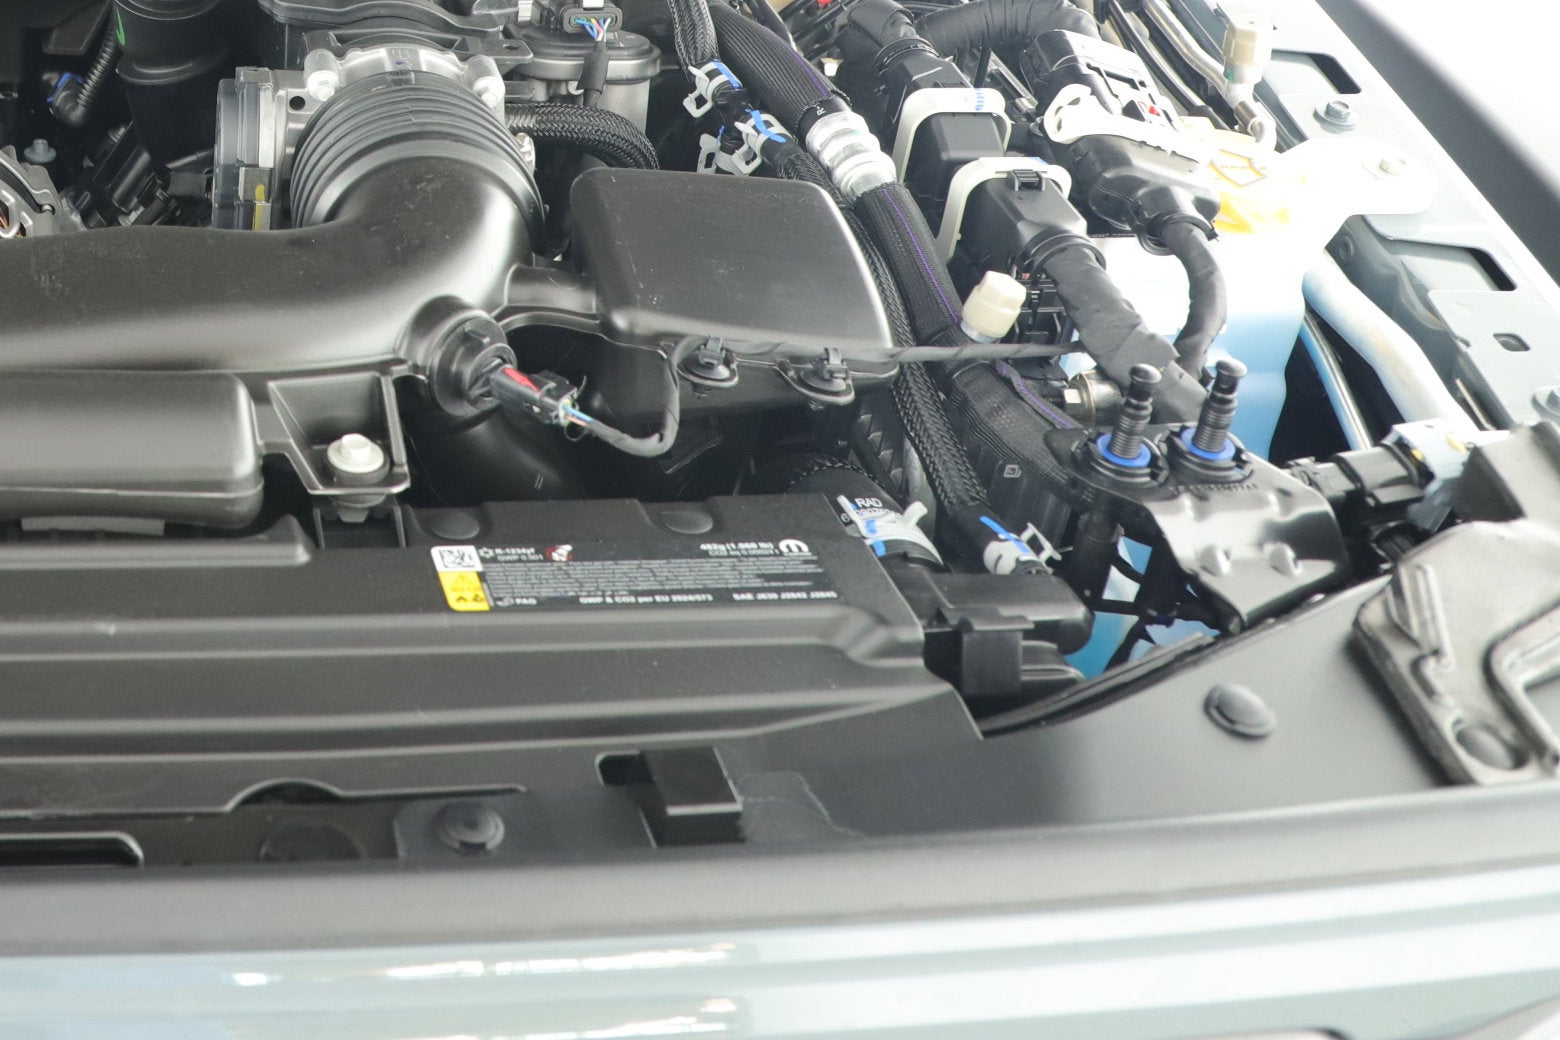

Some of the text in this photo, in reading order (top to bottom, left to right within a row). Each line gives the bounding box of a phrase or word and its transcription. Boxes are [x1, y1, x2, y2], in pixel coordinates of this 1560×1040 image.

[855, 498, 882, 508] RAD
[515, 597, 537, 605] PAG
[654, 594, 670, 602] EU
